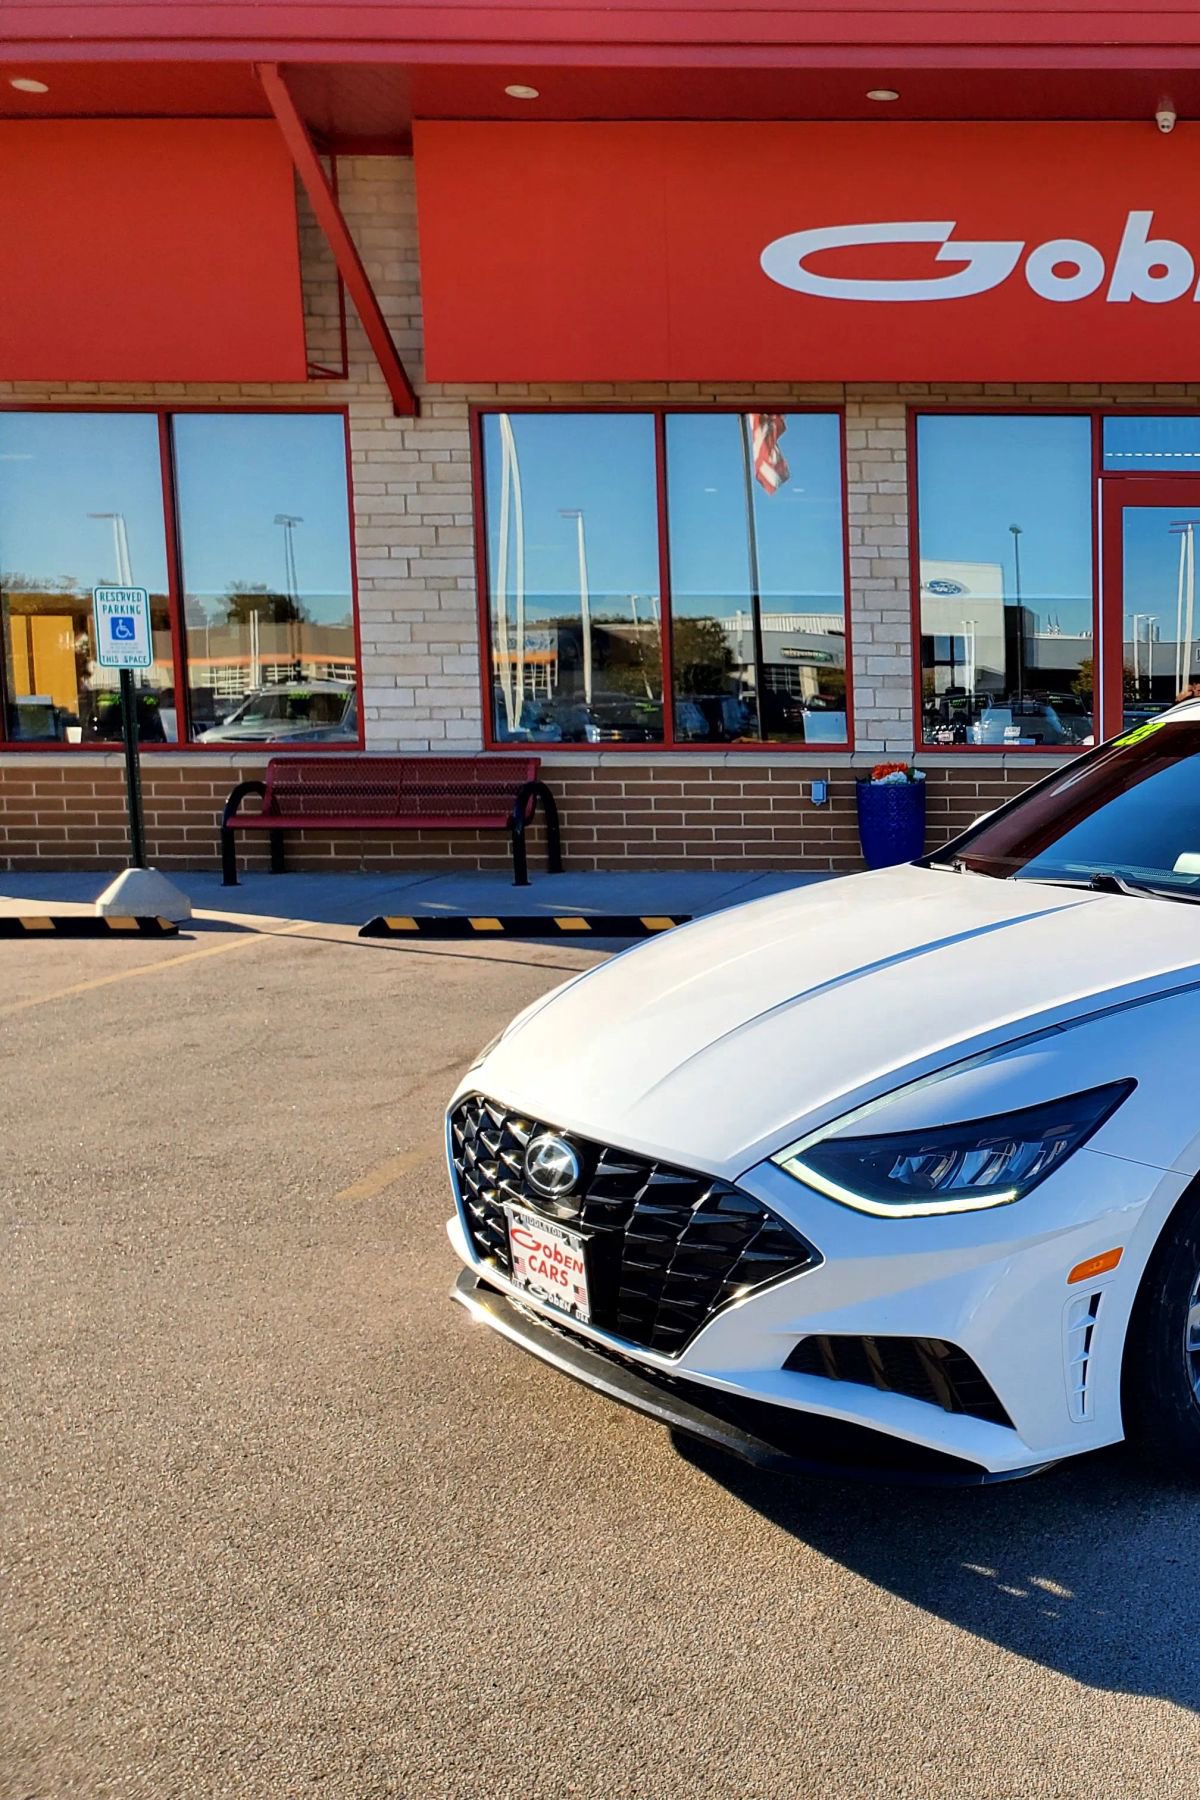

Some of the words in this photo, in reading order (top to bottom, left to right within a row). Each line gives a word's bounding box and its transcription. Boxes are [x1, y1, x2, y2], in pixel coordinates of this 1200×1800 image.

[100, 591, 142, 602] RESERVED
[102, 604, 142, 615] PARKING
[101, 655, 119, 664] THIS
[123, 655, 147, 664] SPACE
[528, 1255, 569, 1287] CARS
